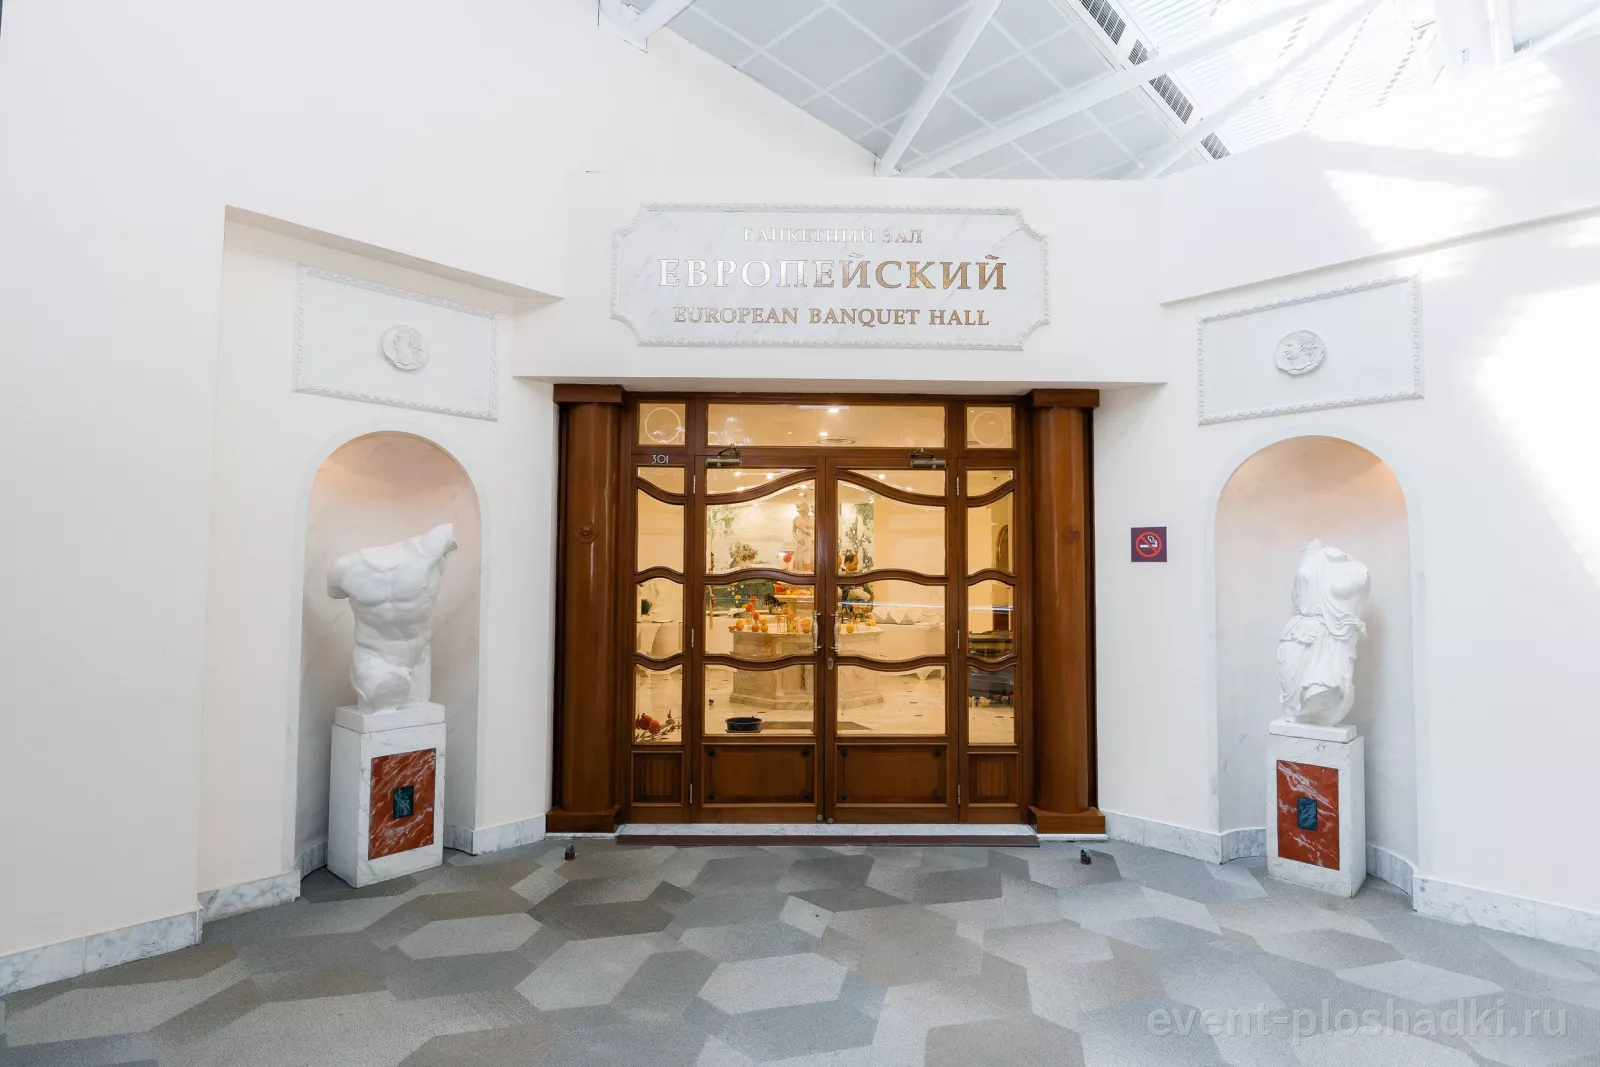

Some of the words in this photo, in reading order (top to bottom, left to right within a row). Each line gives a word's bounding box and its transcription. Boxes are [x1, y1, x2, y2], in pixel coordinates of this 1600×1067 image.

[744, 226, 875, 243] БАНКЕТНЫЙ
[882, 229, 923, 244] ЗАЛ
[657, 252, 1007, 290] ЕВРОПЕЙСКИЙ
[674, 307, 798, 324] EUROPEAN
[809, 308, 920, 327] BANQUET
[929, 309, 989, 326] HALL
[652, 454, 669, 464] 301
